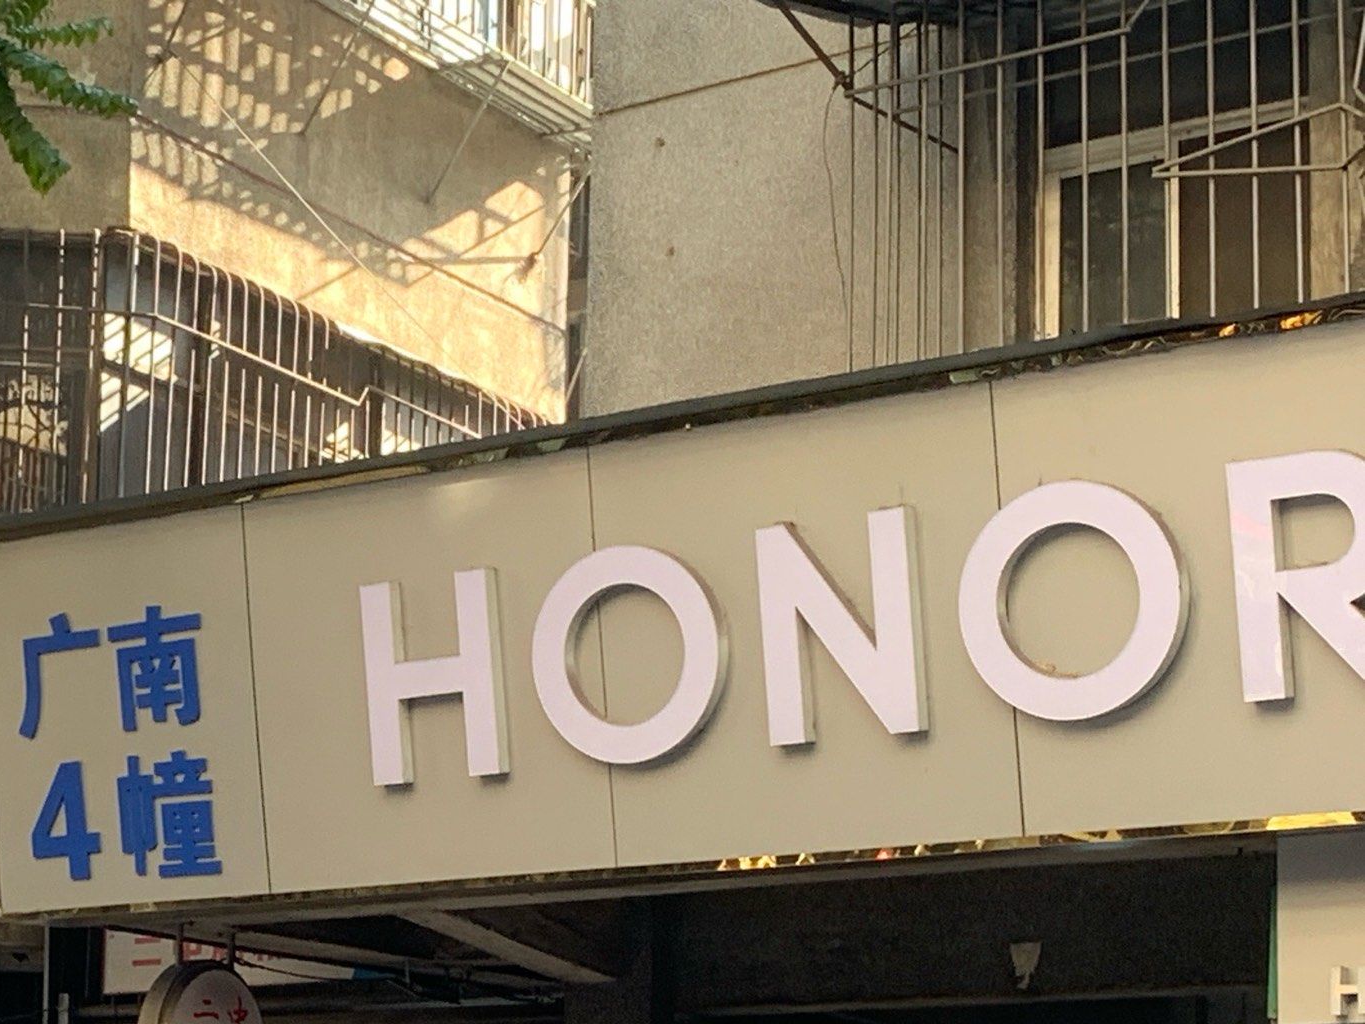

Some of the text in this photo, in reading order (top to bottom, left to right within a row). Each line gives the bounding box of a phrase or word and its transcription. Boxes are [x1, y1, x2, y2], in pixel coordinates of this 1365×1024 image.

[19, 604, 203, 741] 广南
[359, 451, 1365, 787] HONOR
[30, 752, 222, 882] 4幢
